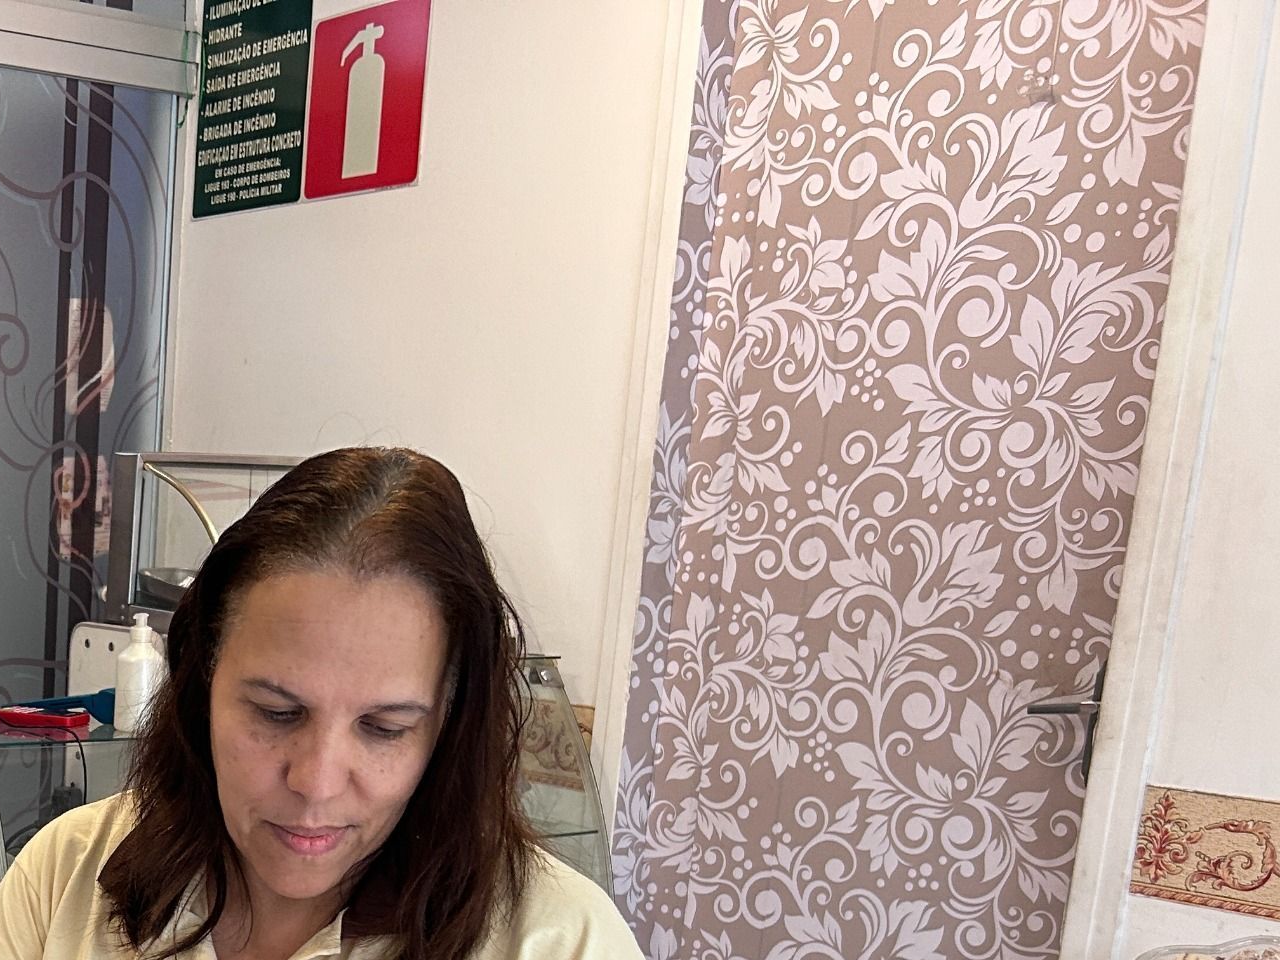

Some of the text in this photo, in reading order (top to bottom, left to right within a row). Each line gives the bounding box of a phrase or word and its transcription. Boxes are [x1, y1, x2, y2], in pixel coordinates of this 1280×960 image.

[207, 28, 308, 69] SINALIZAÇÃO DE EMERGÊNCIA
[208, 22, 242, 45] HIDRANTE
[206, 62, 280, 94] SAÍDA DE EMERGÊNCIA
[204, 88, 275, 118] ALARME DE INCÊNDIO
[204, 112, 276, 142] BRIGADA DE INCÊNDIO
[230, 144, 238, 160] EM
[239, 137, 270, 158] ESTRUTURA
[272, 130, 301, 152] CONCRETO
[204, 181, 220, 193] LIGUE
[233, 177, 250, 188] CORPO
[252, 174, 259, 184] DE
[260, 168, 290, 183] BOMBEIROS
[224, 166, 238, 176] CASO
[238, 164, 246, 174] DE
[211, 194, 226, 205] LIGUE
[260, 184, 282, 196] MILITAR
